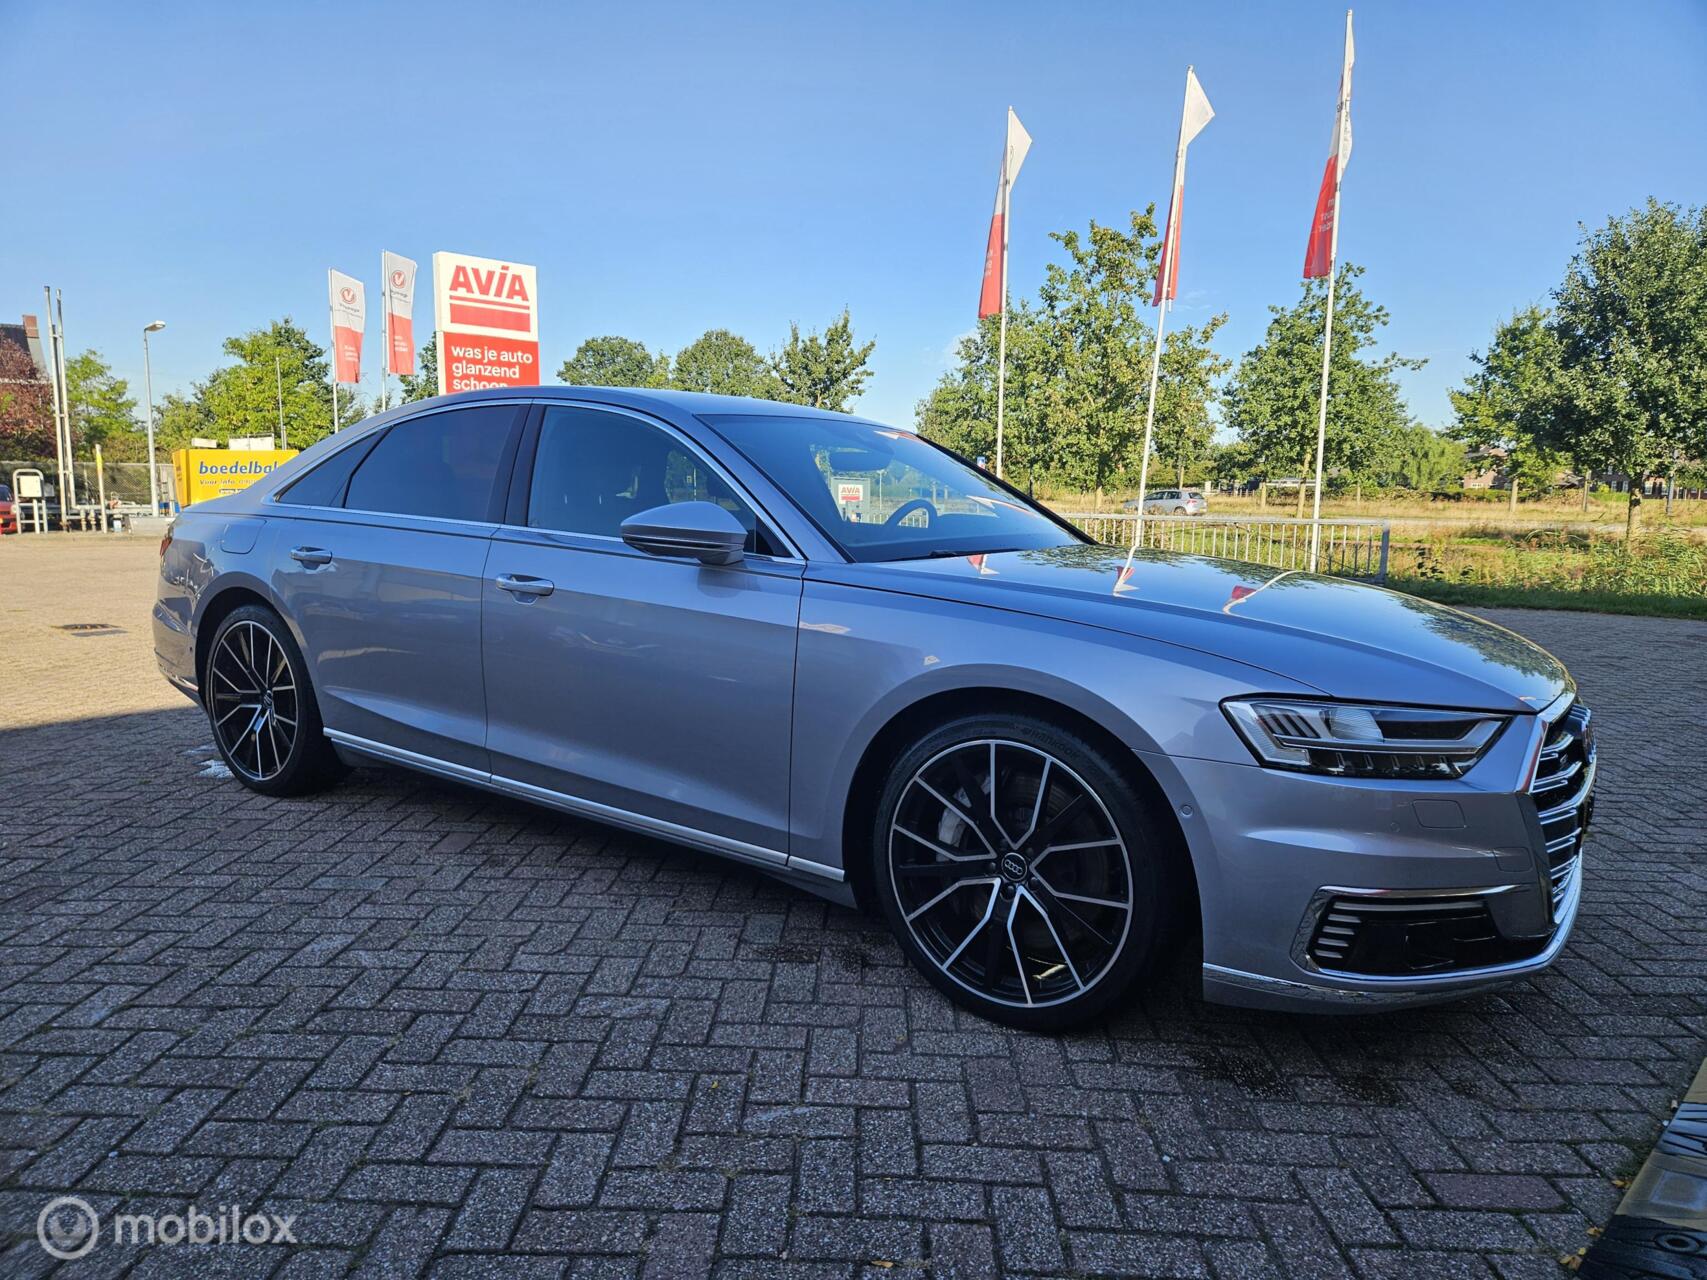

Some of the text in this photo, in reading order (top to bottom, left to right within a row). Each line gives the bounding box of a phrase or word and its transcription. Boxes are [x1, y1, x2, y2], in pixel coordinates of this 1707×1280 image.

[451, 346, 533, 364] was je auto
[452, 361, 520, 379] glanzend
